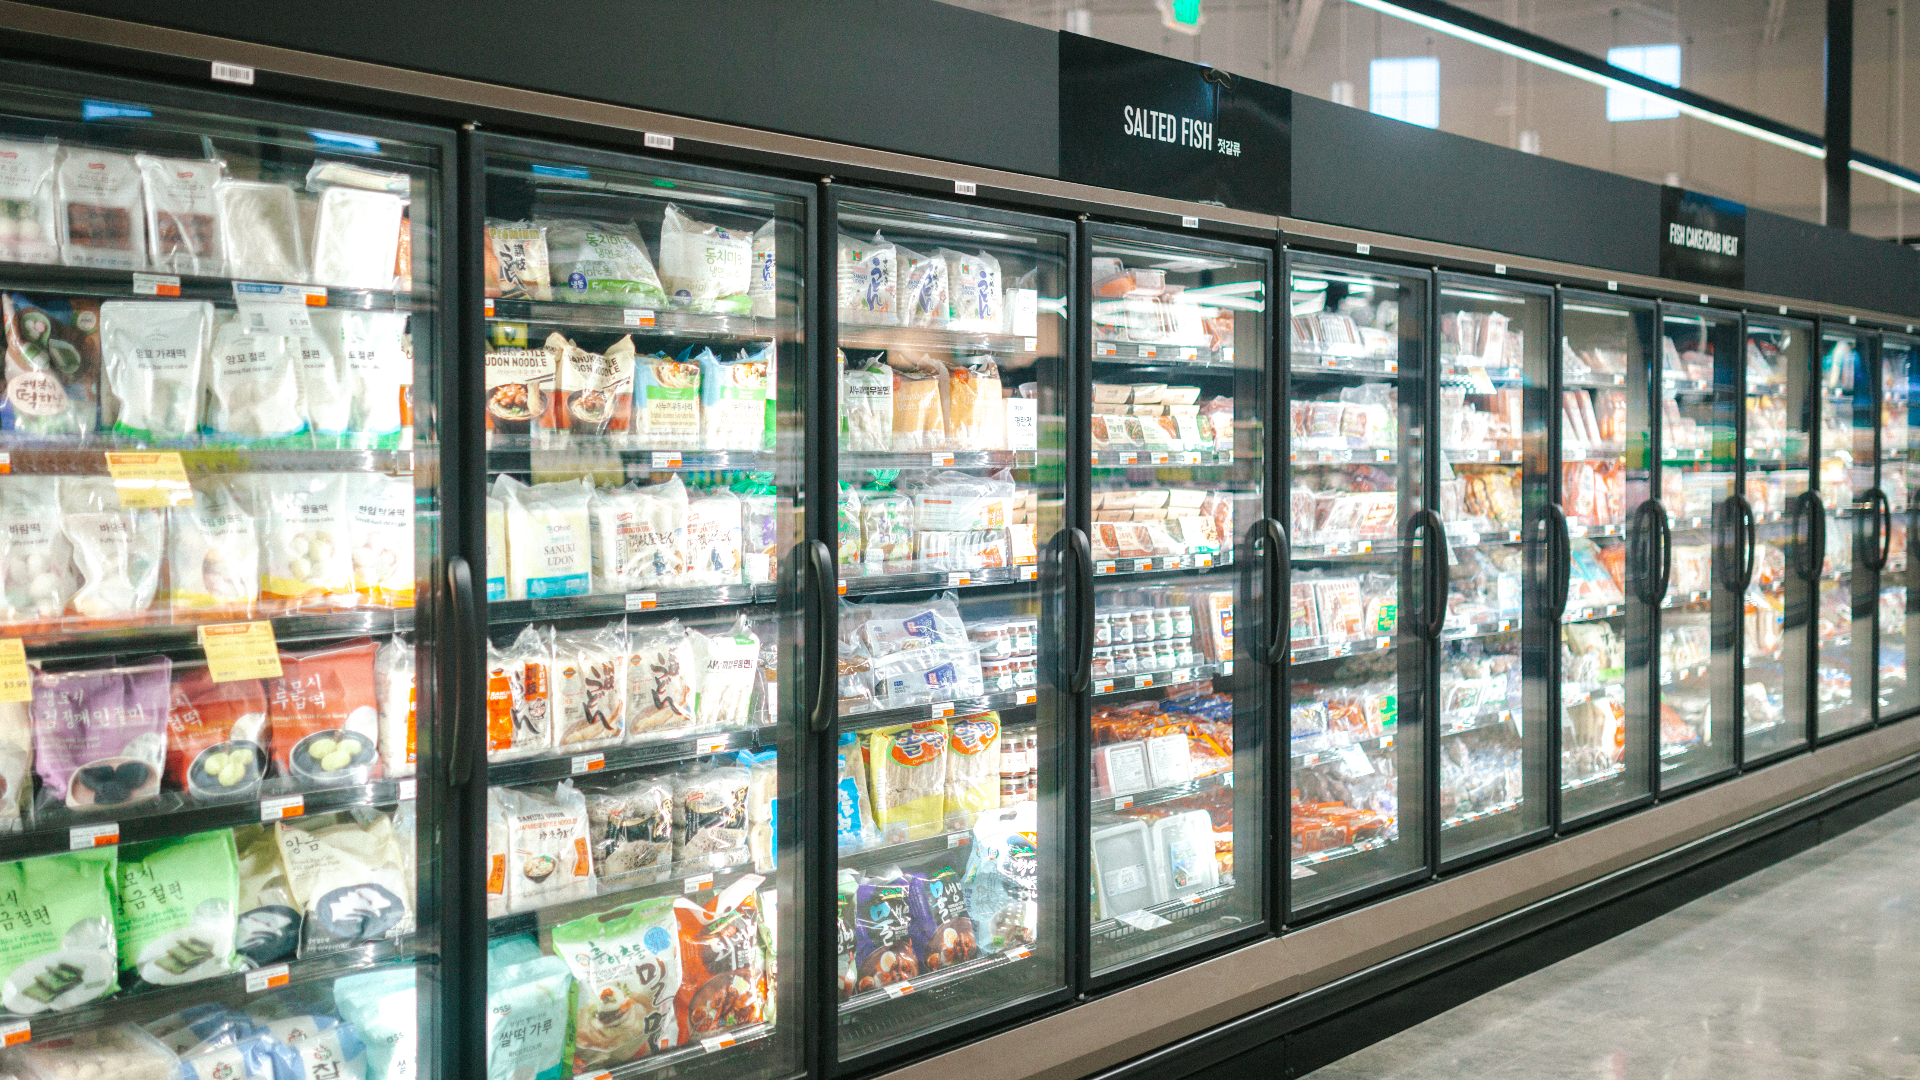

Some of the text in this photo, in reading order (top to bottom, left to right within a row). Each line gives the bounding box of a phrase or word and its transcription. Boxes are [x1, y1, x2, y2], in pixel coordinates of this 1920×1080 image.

[1124, 105, 1213, 151] SALTED FISH
[1217, 138, 1241, 157] 젓갈류
[489, 227, 541, 240] Premium
[1670, 222, 1739, 257] FISH CAKE/CRAB MEAT
[156, 348, 187, 359] 가래떡
[301, 349, 320, 360] 절편
[9, 522, 42, 535] 바람떡
[544, 543, 576, 556] SANUKI
[547, 555, 574, 566] UDON
[3, 680, 27, 690] $3.99
[529, 1018, 553, 1037] 가루
